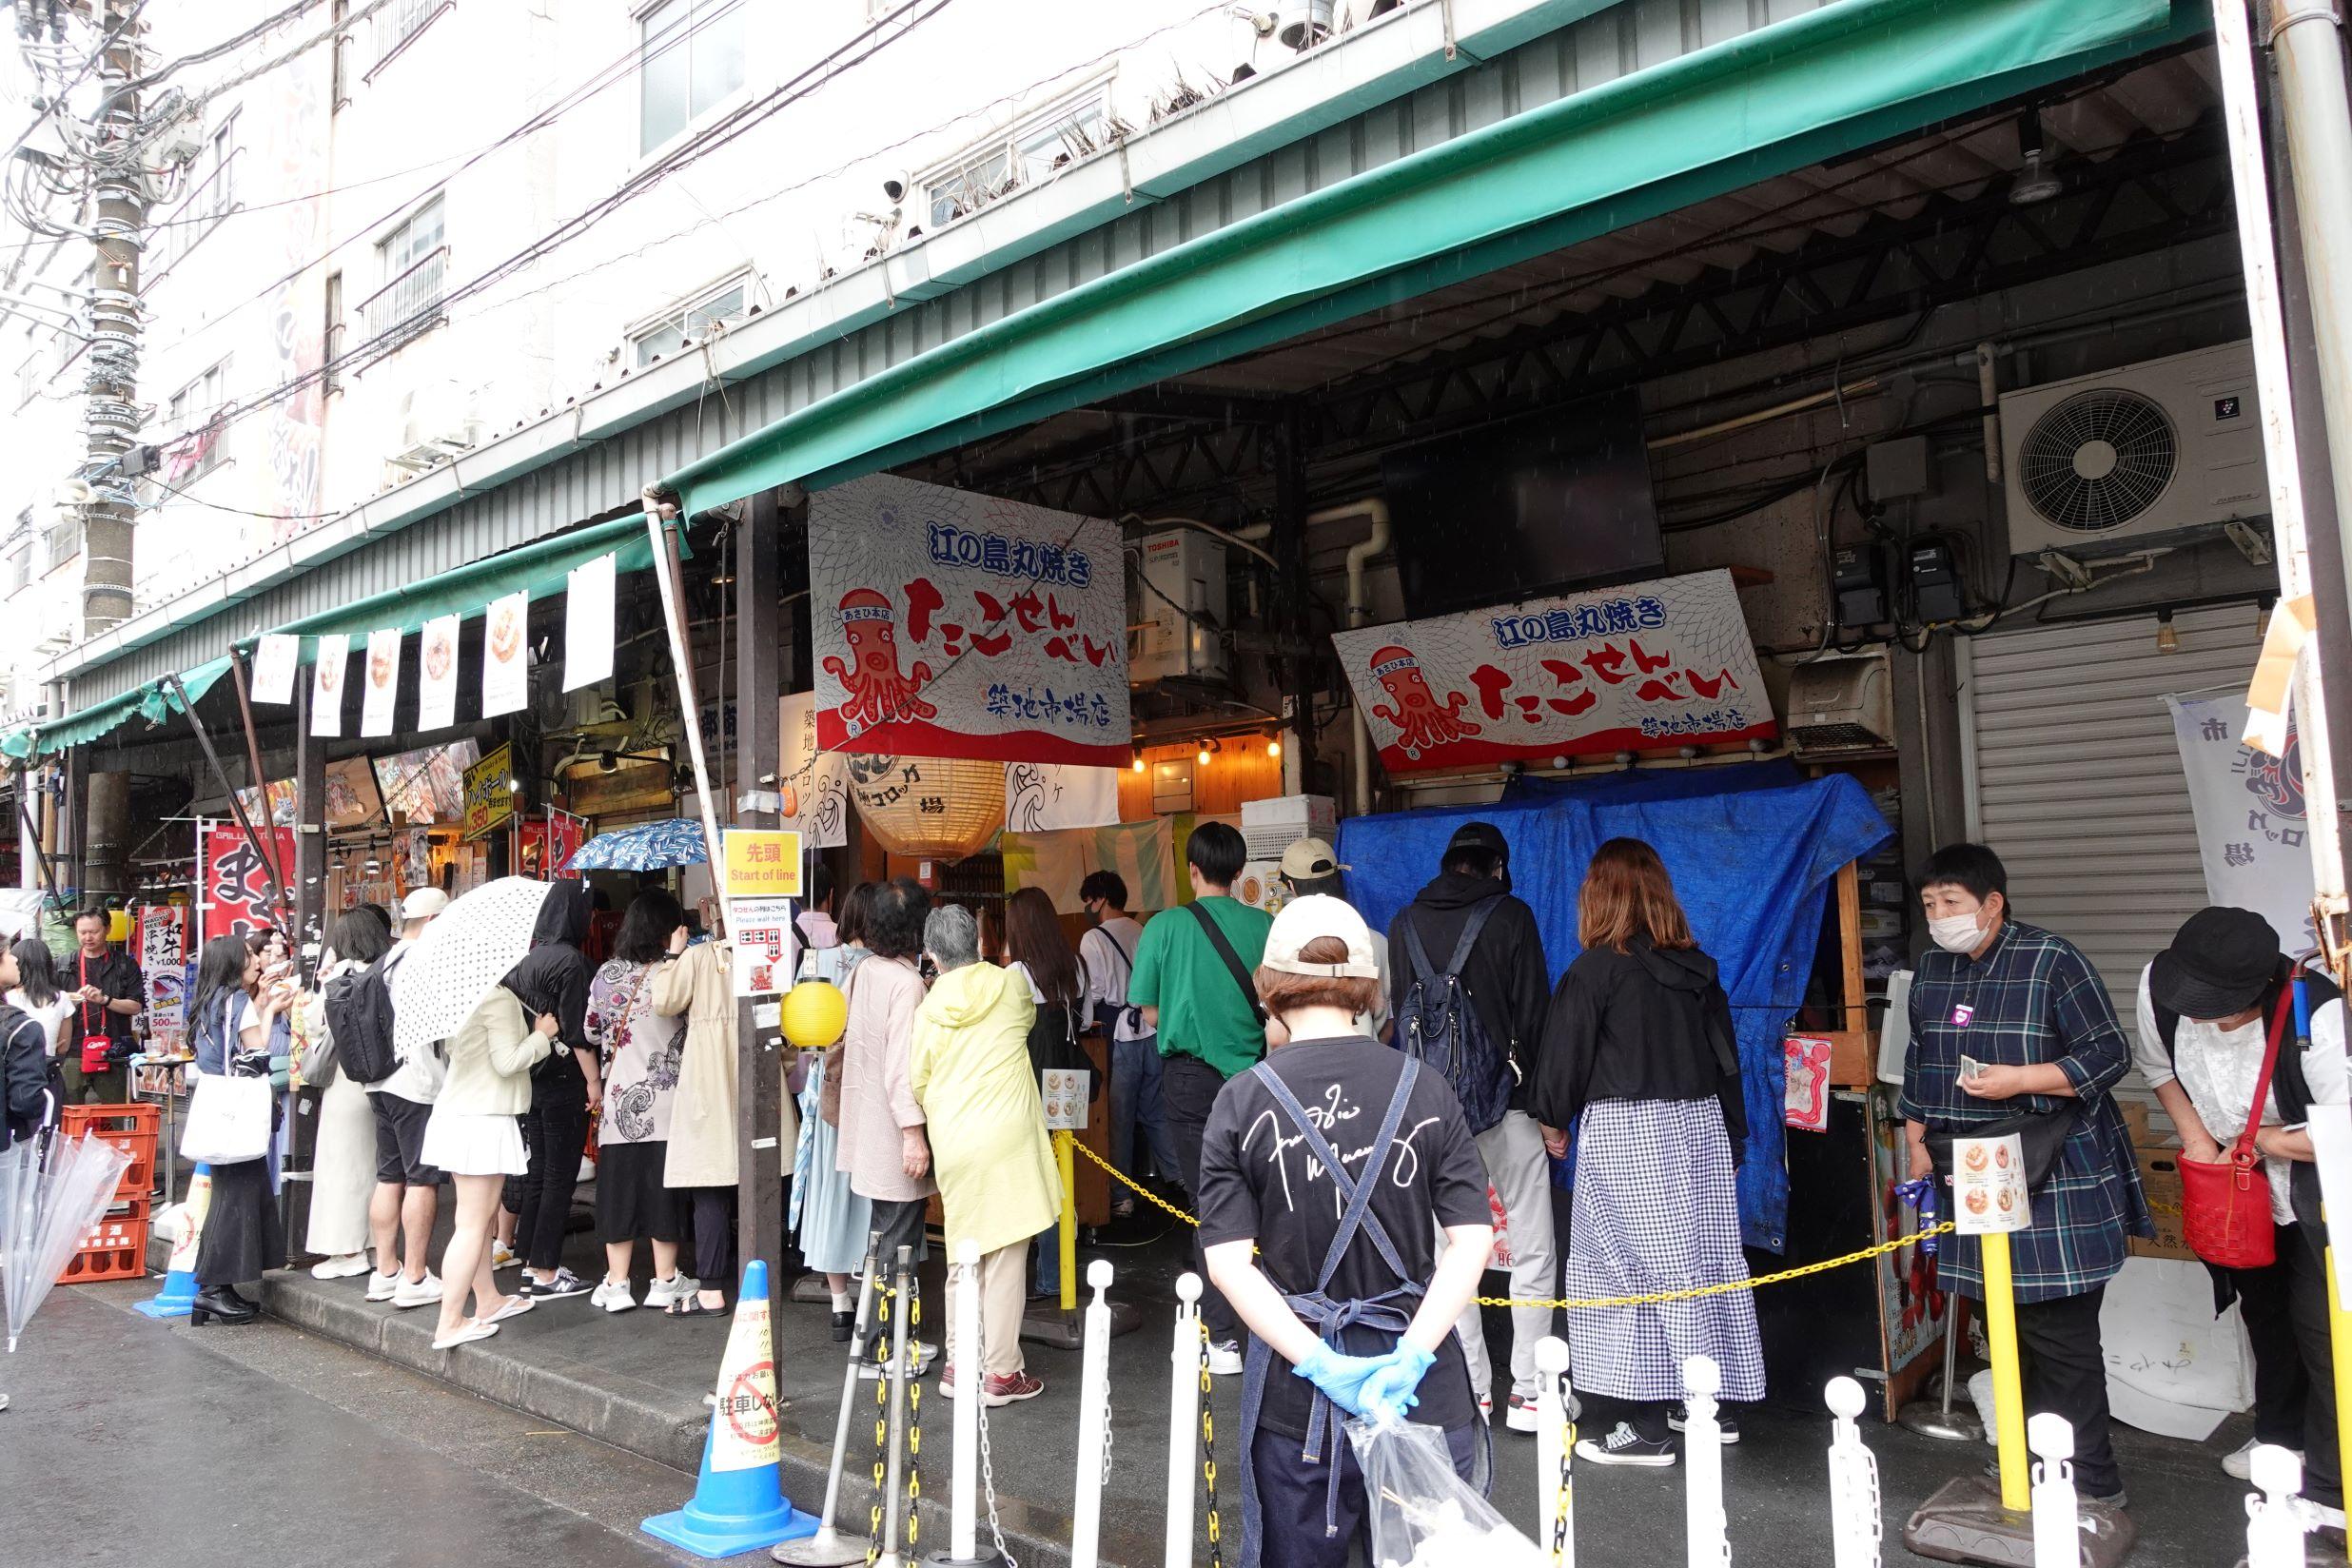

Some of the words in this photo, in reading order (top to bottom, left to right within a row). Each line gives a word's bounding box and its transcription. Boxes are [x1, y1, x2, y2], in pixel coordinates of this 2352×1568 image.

[929, 522, 1090, 587] 江の島丸焼き
[1147, 539, 1180, 552] TOSHIBA
[845, 608, 890, 620] あさひ本店
[904, 578, 1116, 667] たこせんべい
[1494, 597, 1666, 648] 江の島丸焼き
[1377, 658, 1415, 676] あさひ本店
[1469, 639, 1739, 724] たこせんべい
[987, 683, 1110, 727] 築地市場店
[1641, 709, 1747, 738] 築地市場店
[467, 768, 509, 811] ハイボール
[216, 831, 256, 841] GRILLE
[747, 843, 781, 863] 先頭
[731, 870, 759, 881] Start
[762, 869, 774, 881] of
[776, 869, 795, 881] line
[160, 920, 183, 957] 和牛
